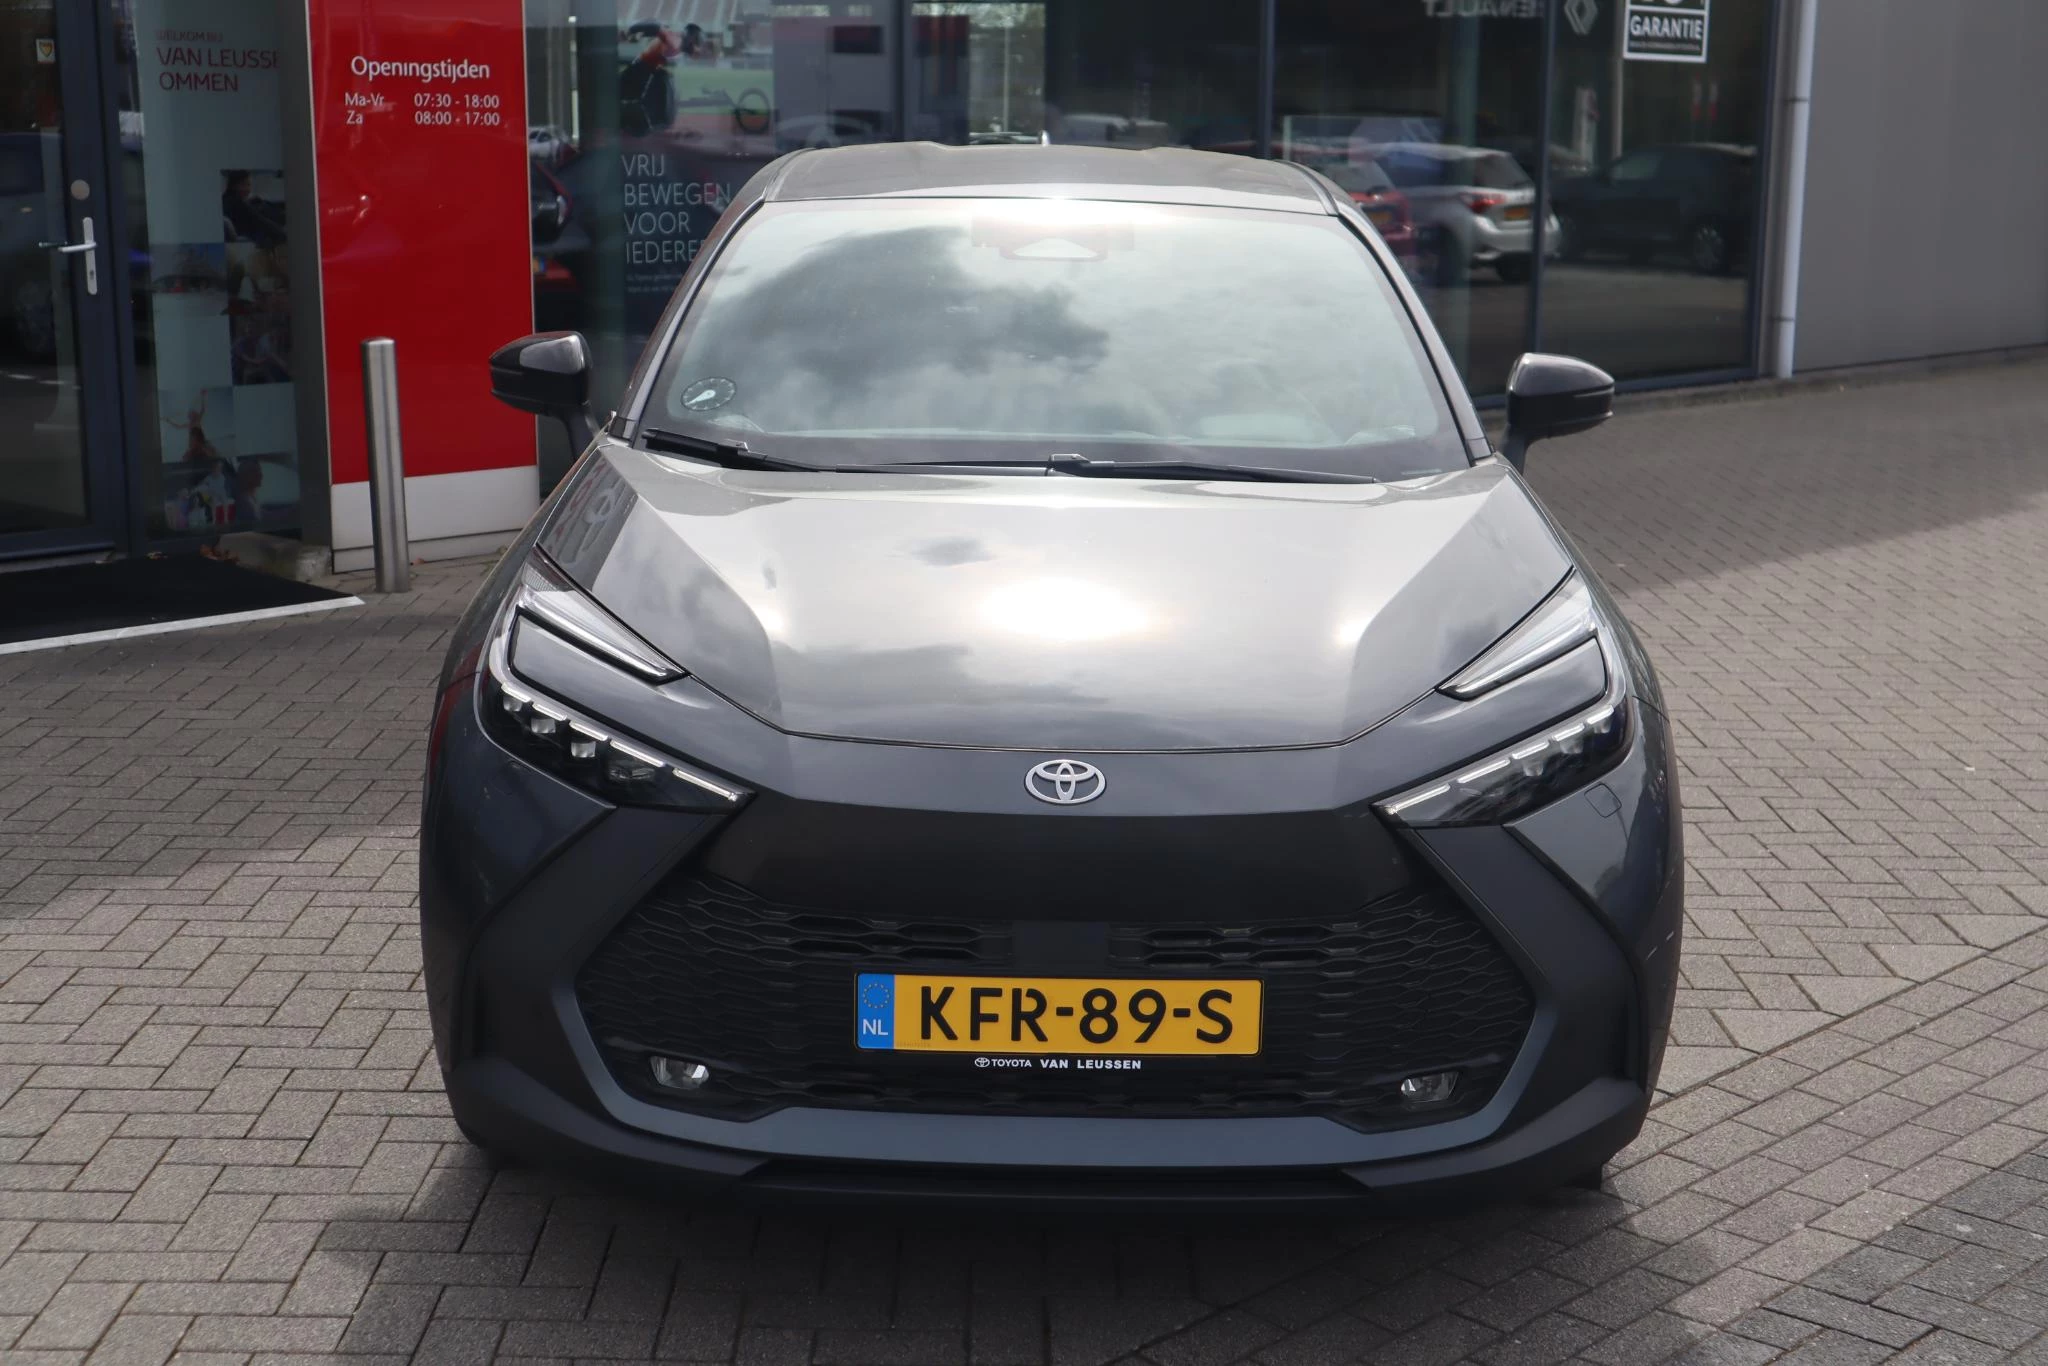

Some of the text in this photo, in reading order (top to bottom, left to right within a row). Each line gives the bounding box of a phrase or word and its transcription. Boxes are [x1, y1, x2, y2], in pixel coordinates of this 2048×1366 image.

[1630, 14, 1703, 40] GARANTIE
[156, 47, 202, 66] VAN
[351, 55, 490, 83] Openingstijden
[159, 71, 239, 91] OMMEN
[344, 92, 385, 106] Ma-Vr
[413, 93, 451, 107] 07:30
[463, 94, 500, 108] 18:00
[346, 110, 363, 125] Za
[415, 111, 451, 125] 08:00
[464, 112, 500, 126] 17:00
[621, 154, 665, 177] VRIJ
[624, 182, 731, 206] BEWEGEN
[623, 211, 691, 235] VOOR
[625, 239, 706, 264] IEDERE
[920, 985, 1234, 1045] KFR-89-S
[862, 1018, 889, 1036] NL
[991, 1059, 1142, 1070] TOYOTA VAN LEUSSEN
